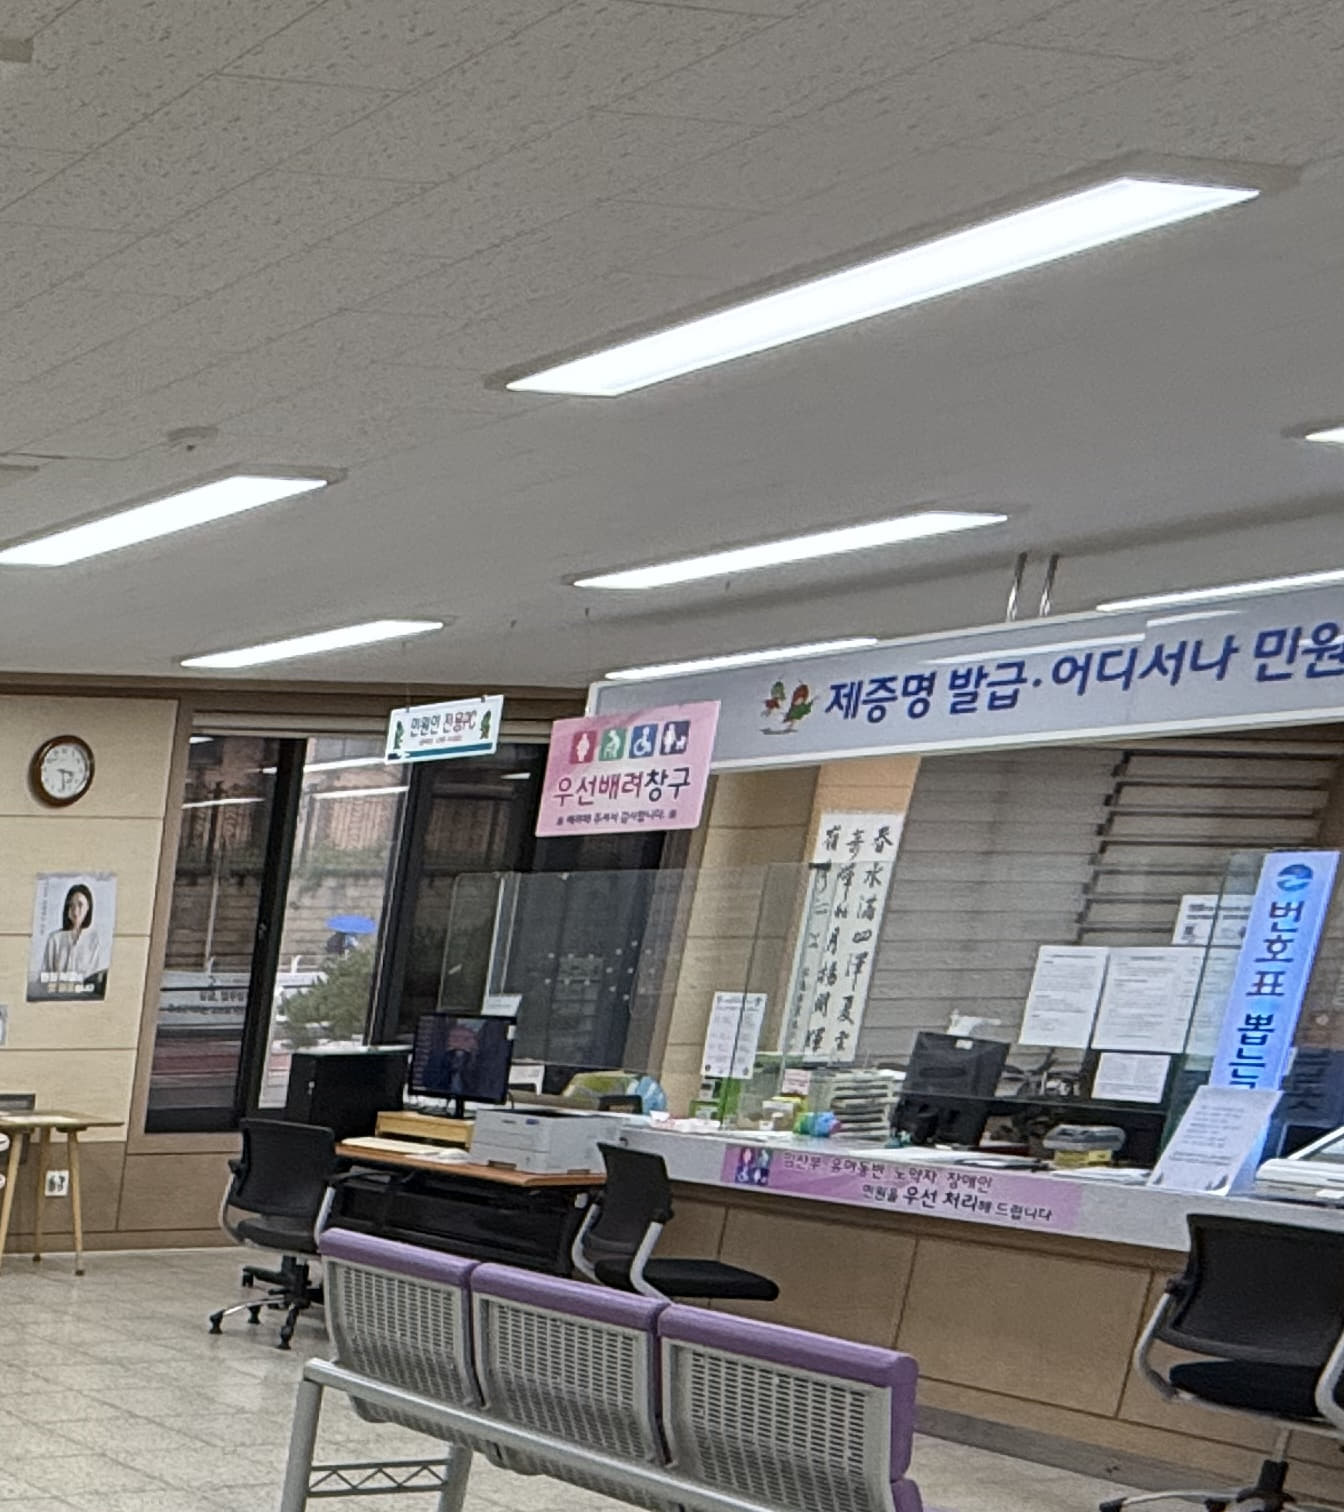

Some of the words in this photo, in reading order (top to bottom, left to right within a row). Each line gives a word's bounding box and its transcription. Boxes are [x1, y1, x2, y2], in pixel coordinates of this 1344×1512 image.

[824, 669, 937, 723] 제증명
[553, 767, 691, 807] 우선배려창구
[1246, 900, 1305, 997] 번호표
[1229, 1012, 1274, 1089] 뽑는
[893, 1164, 939, 1186] 노약자
[946, 1170, 994, 1195] 장애인
[902, 1186, 939, 1209] 우선
[942, 1189, 992, 1215] 처리해
[995, 1202, 1054, 1222] 드립니다
